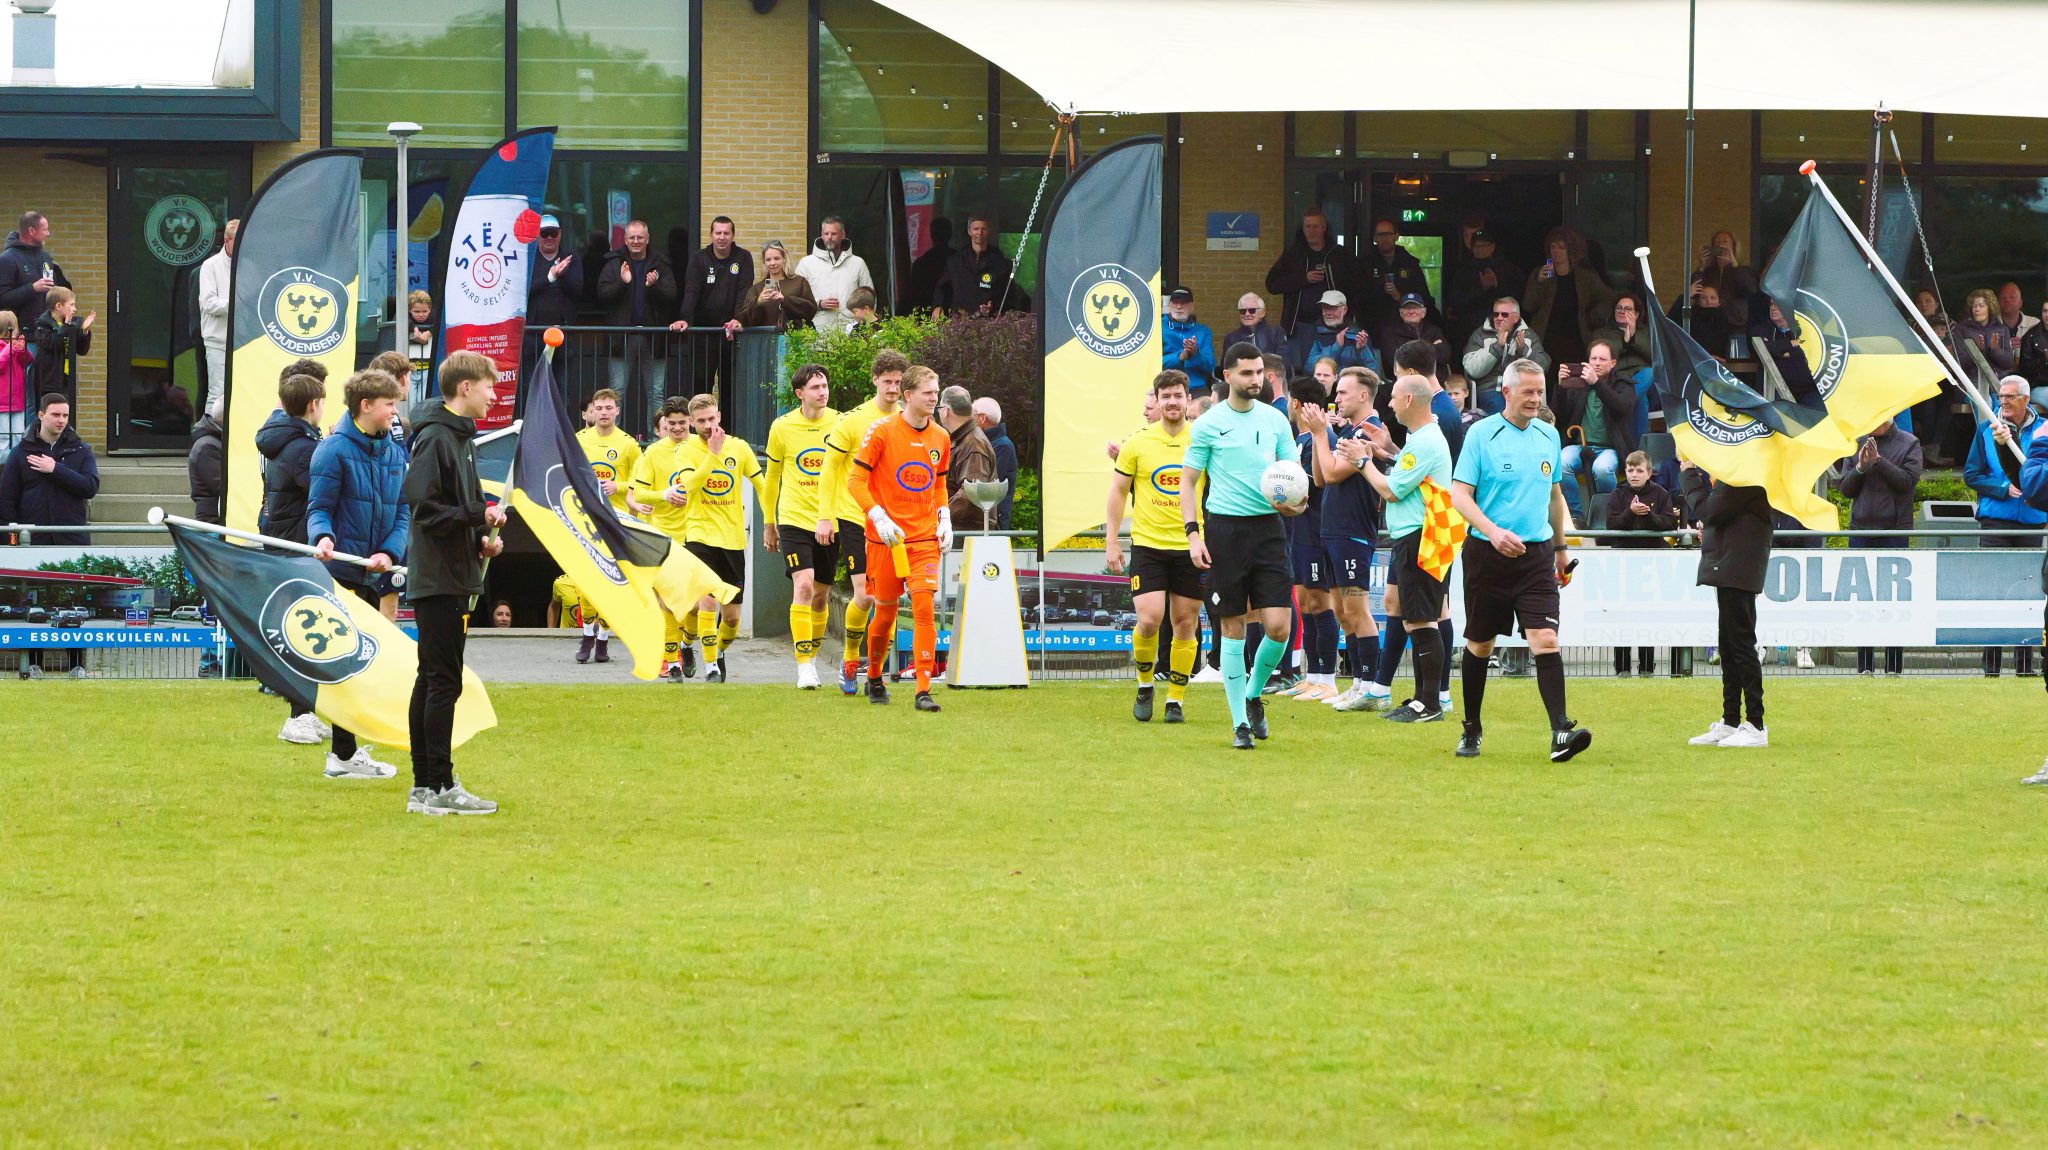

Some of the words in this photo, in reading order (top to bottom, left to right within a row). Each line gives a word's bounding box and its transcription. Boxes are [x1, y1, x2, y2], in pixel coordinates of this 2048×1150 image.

[173, 199, 188, 207] V.V.
[151, 238, 209, 262] WOUDENBERG
[455, 222, 518, 270] STËLZ
[292, 271, 316, 284] V.V.
[1099, 269, 1122, 280] V.V.
[460, 281, 480, 304] HARD
[483, 278, 512, 306] SELTZER
[266, 321, 341, 353] WOUDENBERG
[1075, 322, 1146, 355] WOUDENBERG
[1690, 408, 1769, 442] WOUDENBERG
[802, 457, 823, 467] Ess
[706, 478, 729, 489] Esso
[903, 470, 928, 484] Esso
[1159, 473, 1180, 486] Ess
[1151, 498, 1181, 507] Vosku
[786, 552, 800, 568] 11
[847, 555, 855, 570] 3
[1344, 558, 1357, 570] 15
[1310, 562, 1319, 574] 11
[1130, 575, 1141, 592] 10
[1763, 555, 1913, 603] OLAR
[30, 631, 191, 643] ESSOVOSKUILEN.NL
[1026, 634, 1096, 646] udenberg
[1583, 628, 1690, 643] ENERGY
